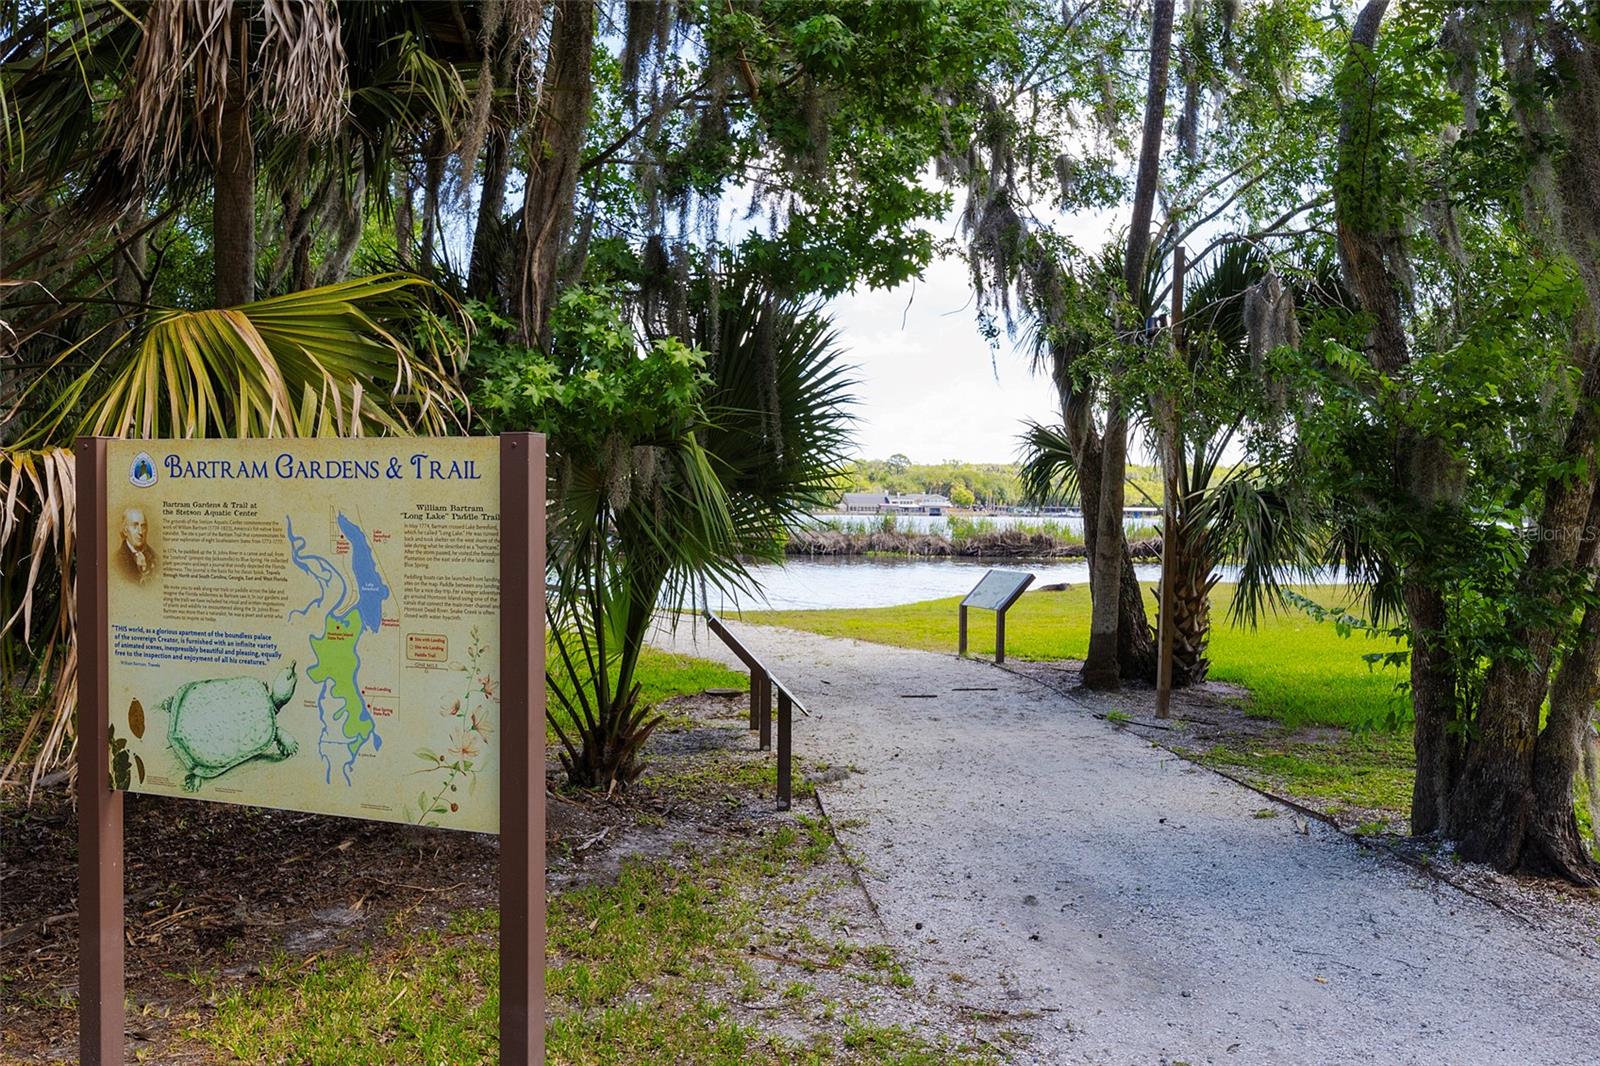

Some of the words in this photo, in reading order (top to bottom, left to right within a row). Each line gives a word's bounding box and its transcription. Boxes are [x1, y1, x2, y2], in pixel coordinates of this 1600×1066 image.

[164, 454, 268, 479] BARTRAM
[274, 454, 380, 479] GARDENS
[386, 457, 402, 479] &
[410, 454, 481, 479] TRAIL
[128, 626, 144, 635] world,
[156, 628, 177, 637] glorious
[178, 629, 206, 638] apartment
[253, 633, 271, 642] palace
[131, 634, 156, 644] sovereign
[157, 636, 178, 645] Creator,
[256, 641, 277, 650] variety
[143, 651, 171, 661] inspection
[184, 654, 212, 663] enjoyment
[164, 645, 198, 654] inexpressibly
[236, 649, 259, 658] pleasing,
[260, 650, 281, 659] equally
